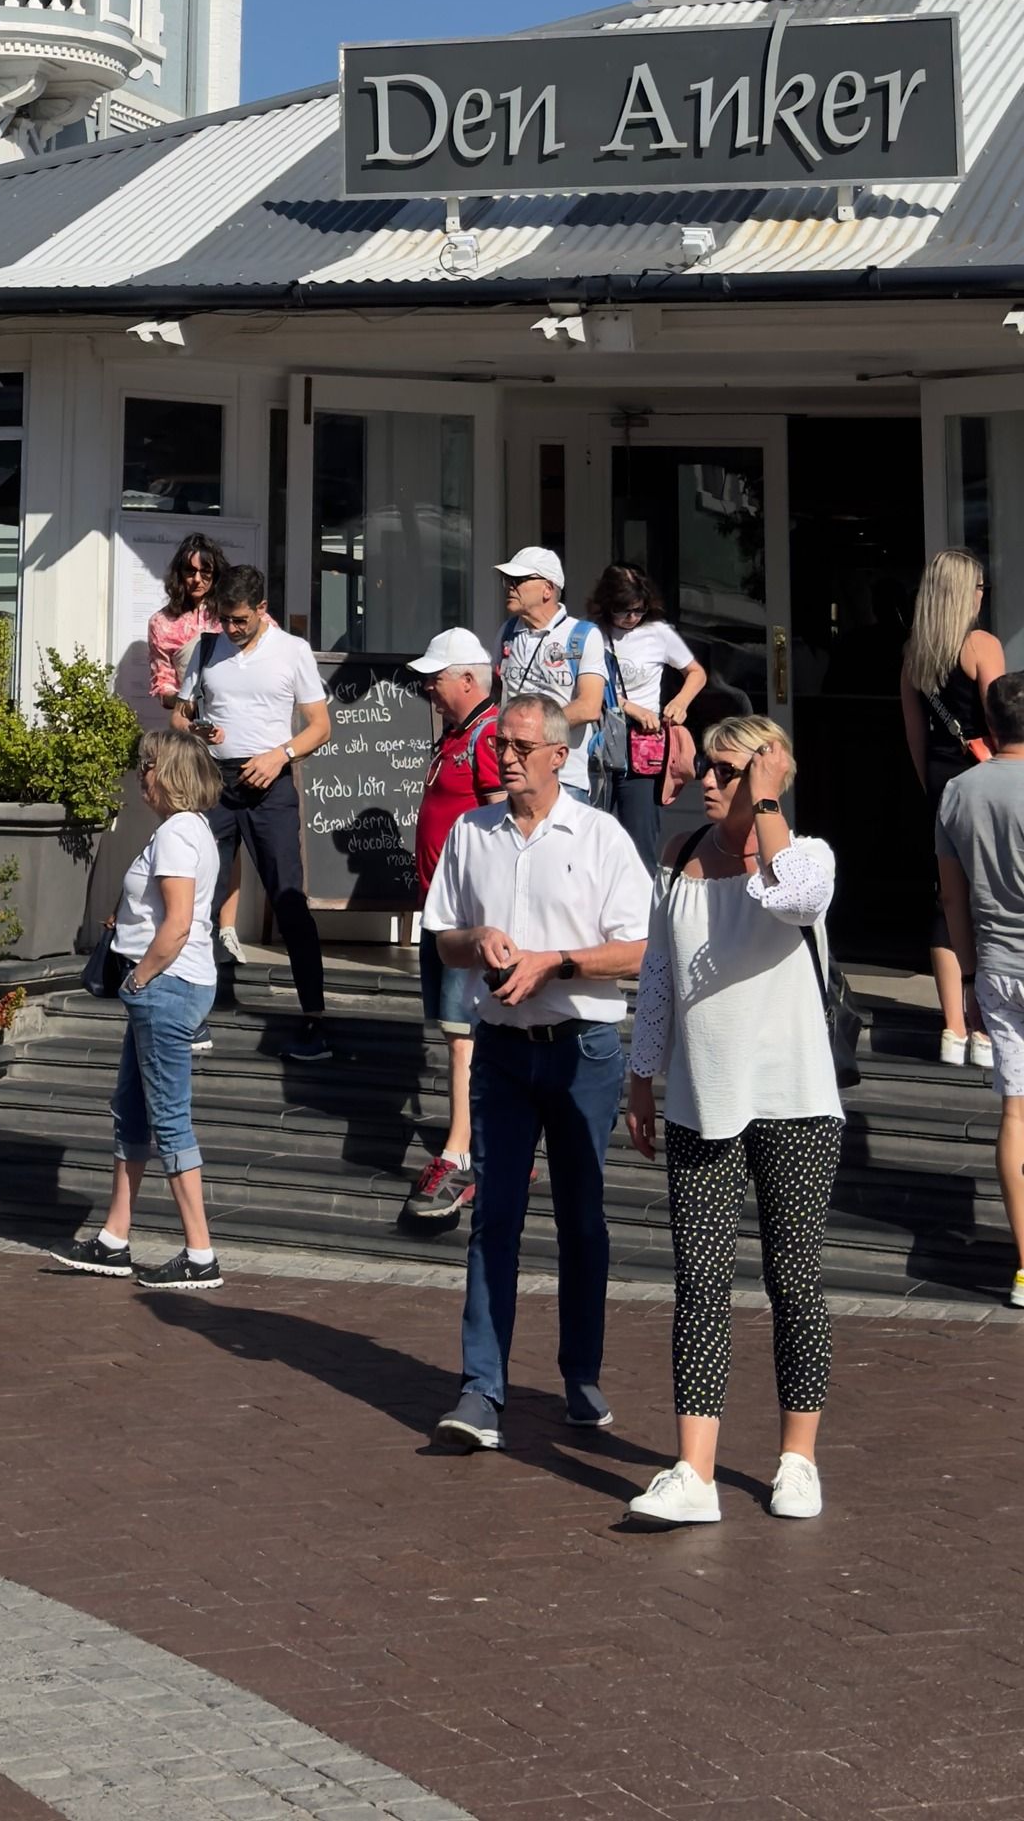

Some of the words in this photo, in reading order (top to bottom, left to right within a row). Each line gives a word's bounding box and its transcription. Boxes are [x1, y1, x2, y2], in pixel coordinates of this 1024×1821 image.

[363, 72, 566, 163] Den
[599, 8, 927, 162] Anker
[363, 668, 422, 708] Anker
[335, 707, 391, 724] SPECIALS
[344, 733, 369, 754] with
[375, 739, 405, 758] caper
[311, 775, 352, 804] Kudu
[358, 774, 386, 797] Loin
[312, 809, 395, 838] Strawberry
[347, 831, 405, 853] chocolate
